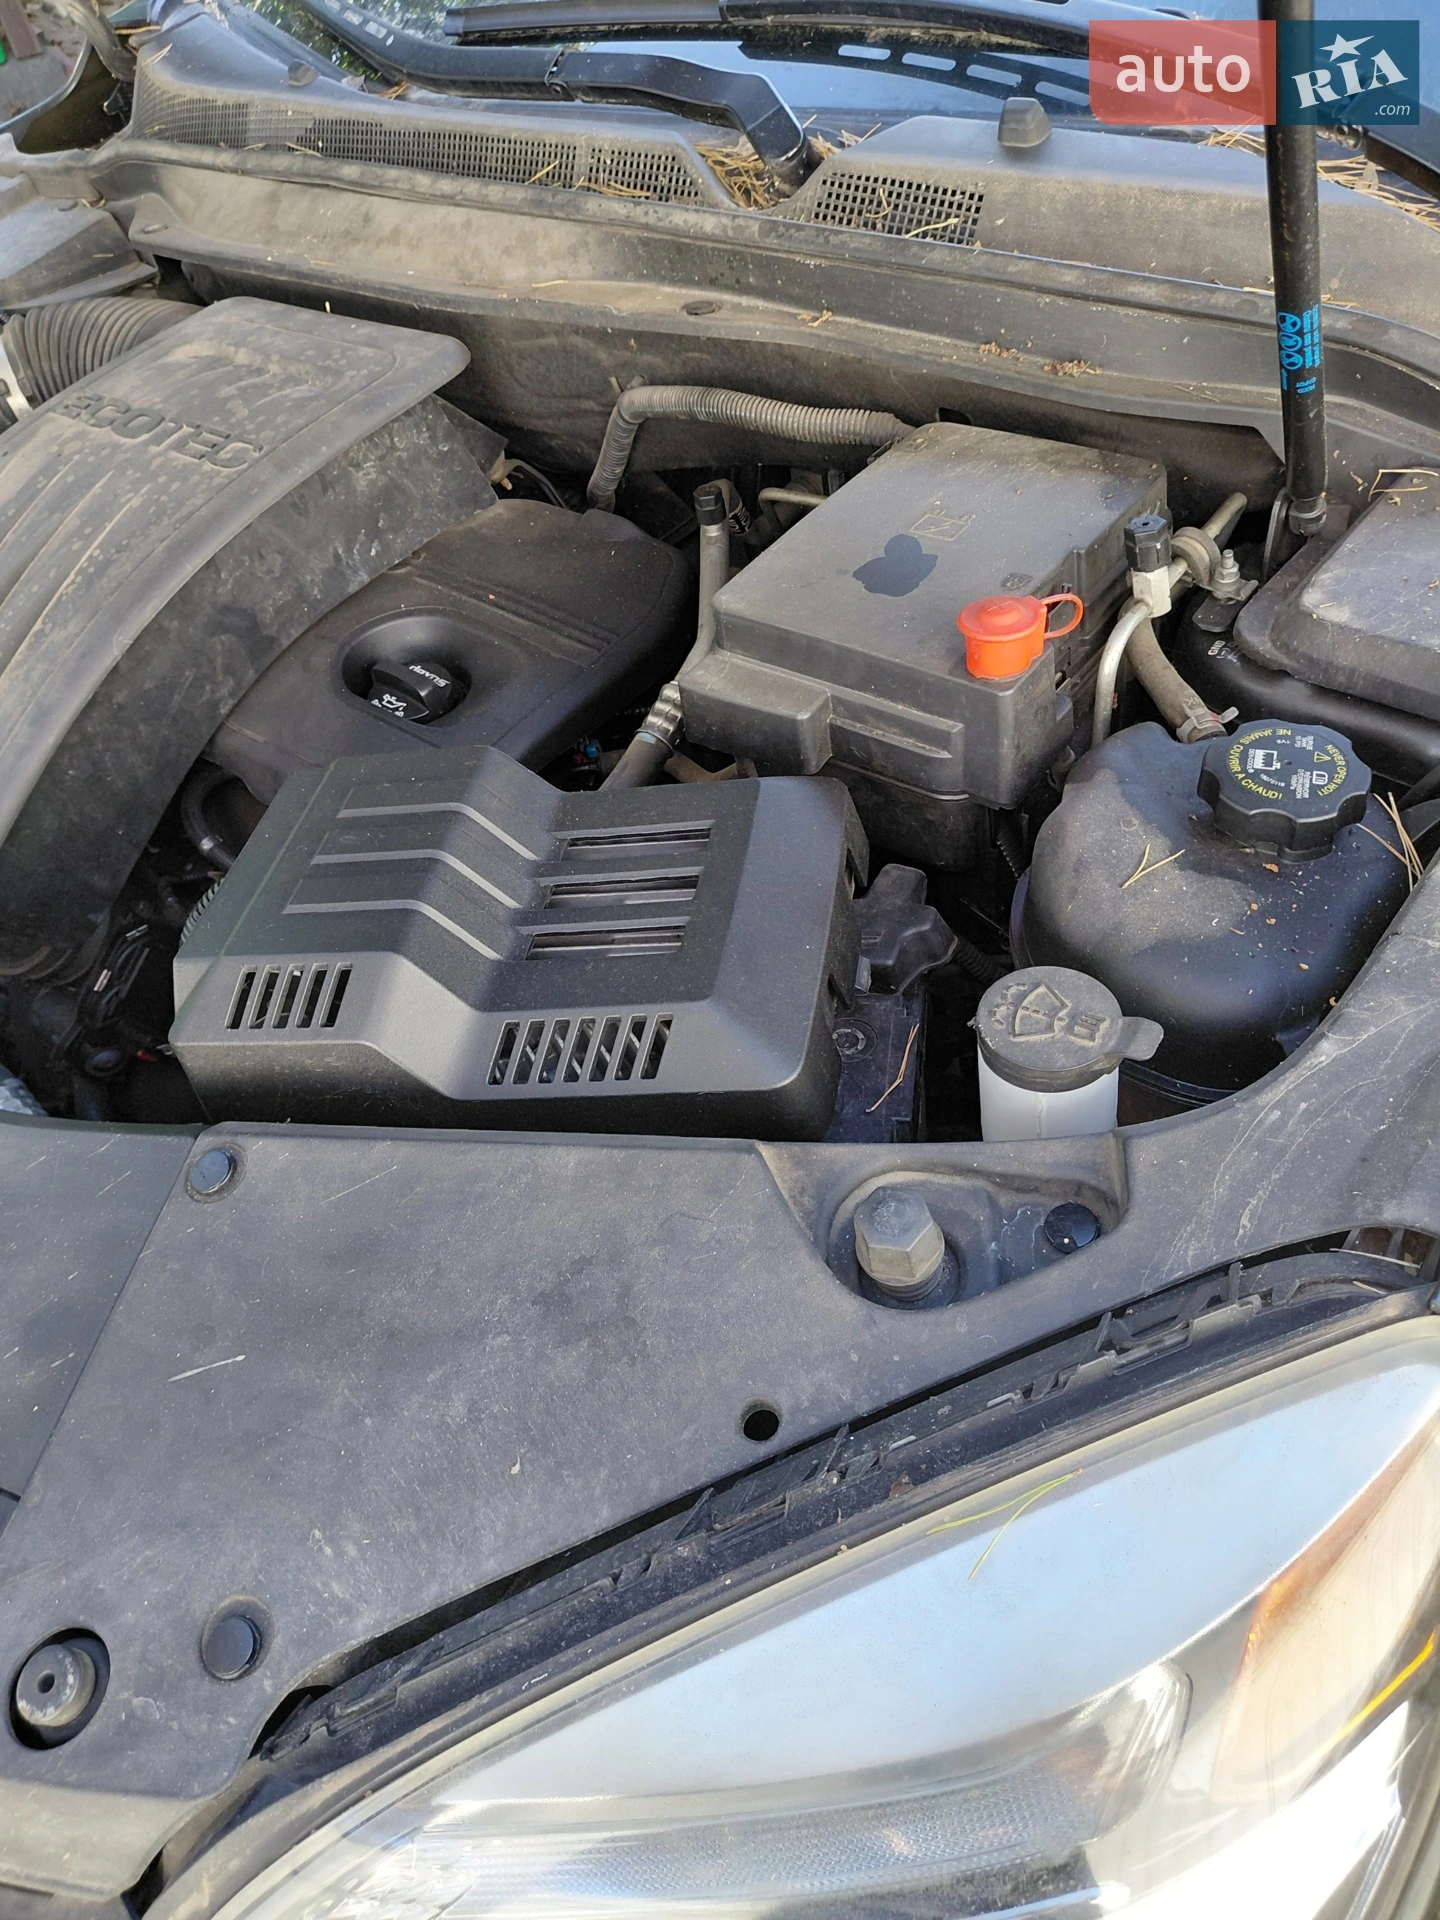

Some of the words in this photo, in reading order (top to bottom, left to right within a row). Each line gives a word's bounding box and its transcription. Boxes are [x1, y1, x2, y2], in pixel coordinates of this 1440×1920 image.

[48, 391, 264, 470] ECOTEC
[1208, 640, 1225, 655] GND
[1240, 729, 1273, 745] JAMAIS
[1229, 744, 1244, 772] OUVRIR
[1325, 744, 1345, 766] NEVER
[1332, 766, 1347, 784] OPEN
[1317, 782, 1339, 796] HOT!
